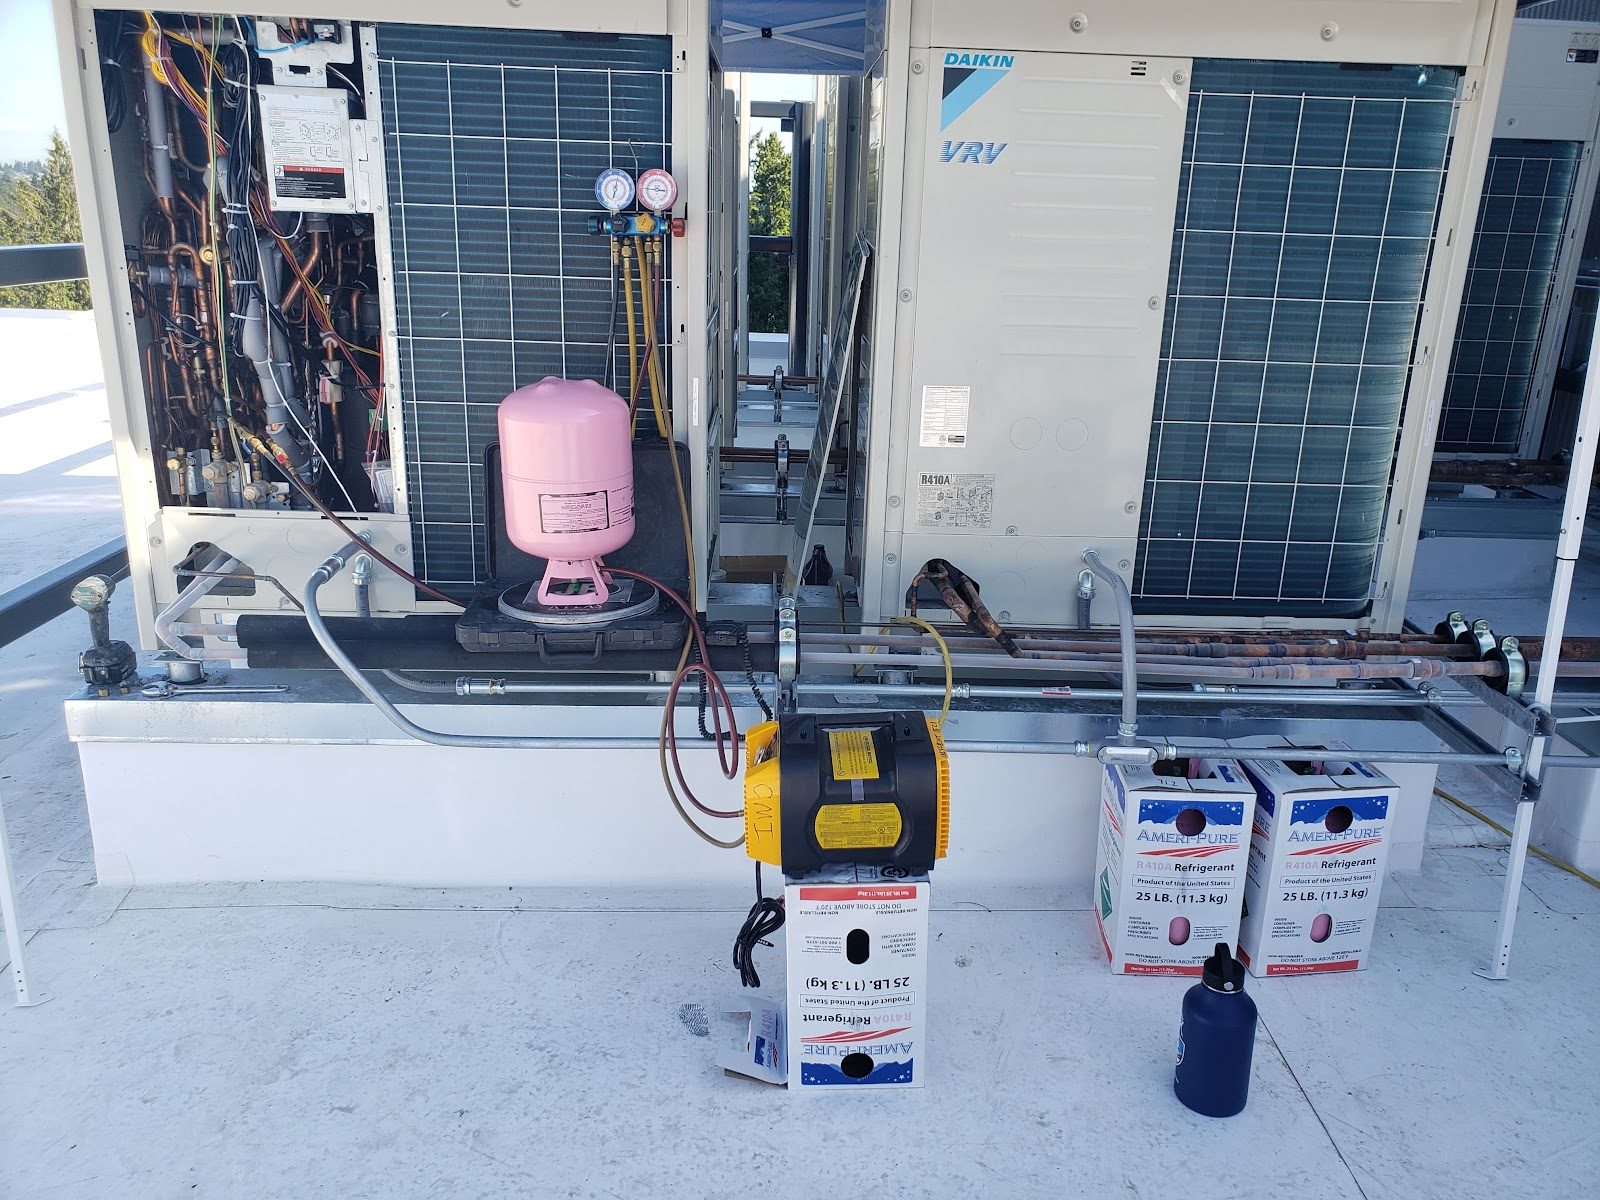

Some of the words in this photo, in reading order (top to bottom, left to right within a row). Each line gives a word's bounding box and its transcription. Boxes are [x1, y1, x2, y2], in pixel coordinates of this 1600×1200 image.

[944, 52, 1014, 68] DAIKIN
[939, 140, 1008, 164] VRV
[921, 474, 950, 485] R410A
[753, 784, 774, 844] CMI
[1136, 828, 1238, 844] AMERI-PURE
[1288, 827, 1381, 842] AMERI-PURE
[1136, 861, 1172, 871] R410A
[1174, 863, 1235, 874] Refrigerant
[1285, 861, 1318, 870] R410A
[1321, 858, 1376, 870] Refrigerant
[1137, 878, 1164, 886] Product
[1136, 892, 1151, 901] 25
[1154, 894, 1173, 902] LB.
[1176, 894, 1206, 904] (11.3
[1209, 894, 1228, 904] kg)
[1282, 892, 1297, 901] 25
[1300, 892, 1318, 901] LB.
[1320, 890, 1348, 902] (11.3
[1351, 888, 1368, 900] kg)
[805, 977, 828, 990] kg)
[831, 980, 866, 991] (11.3
[870, 979, 890, 989] LB.
[894, 976, 910, 988] 25
[880, 995, 910, 1004] Product
[803, 1014, 871, 1025] Refrigerant
[874, 1012, 912, 1023] R410A
[803, 1042, 913, 1056] AMERI-PURE
